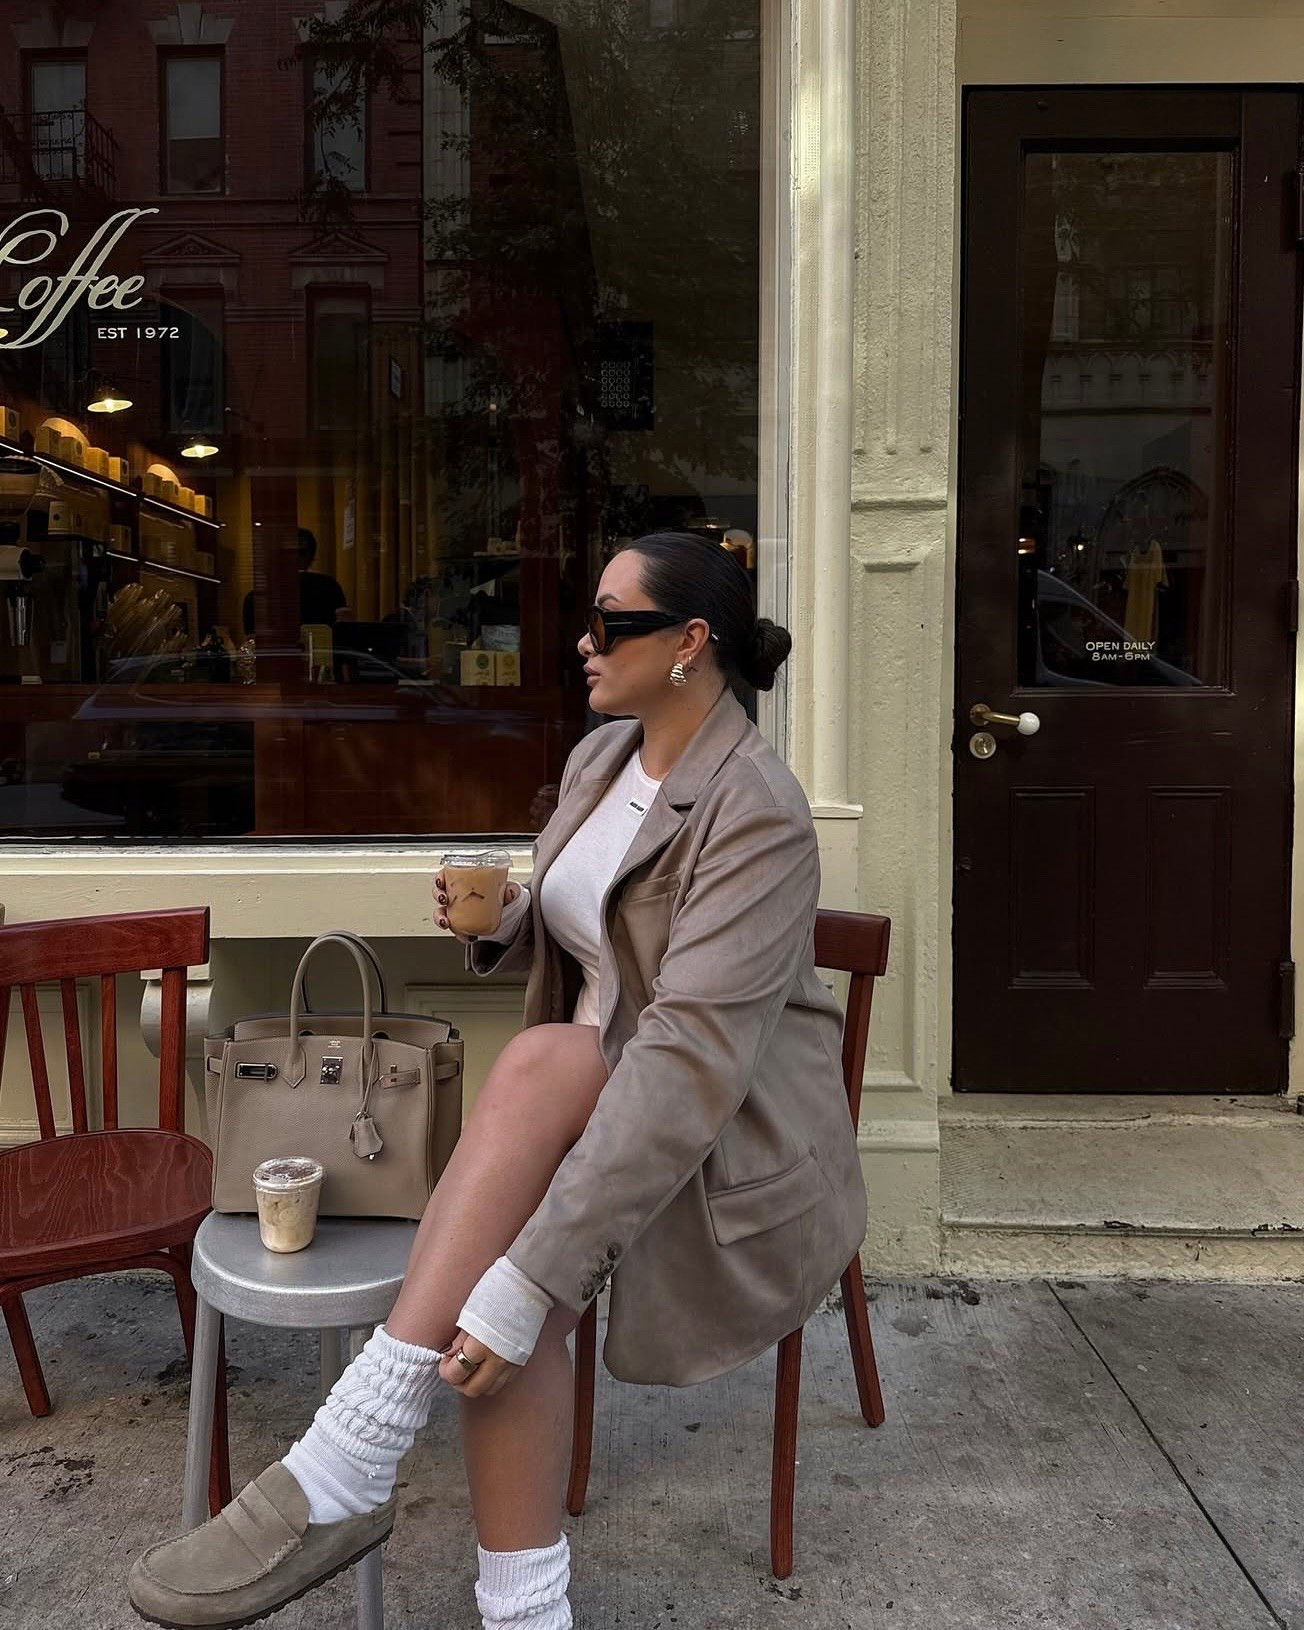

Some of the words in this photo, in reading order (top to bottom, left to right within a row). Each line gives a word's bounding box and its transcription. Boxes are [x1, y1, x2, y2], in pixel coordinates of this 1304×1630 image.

[97, 327, 128, 340] EST
[136, 326, 180, 339] 1972
[1085, 641, 1120, 651] OPEN
[1123, 641, 1156, 651] DAILY
[1091, 652, 1151, 662] 8AM-6PM
